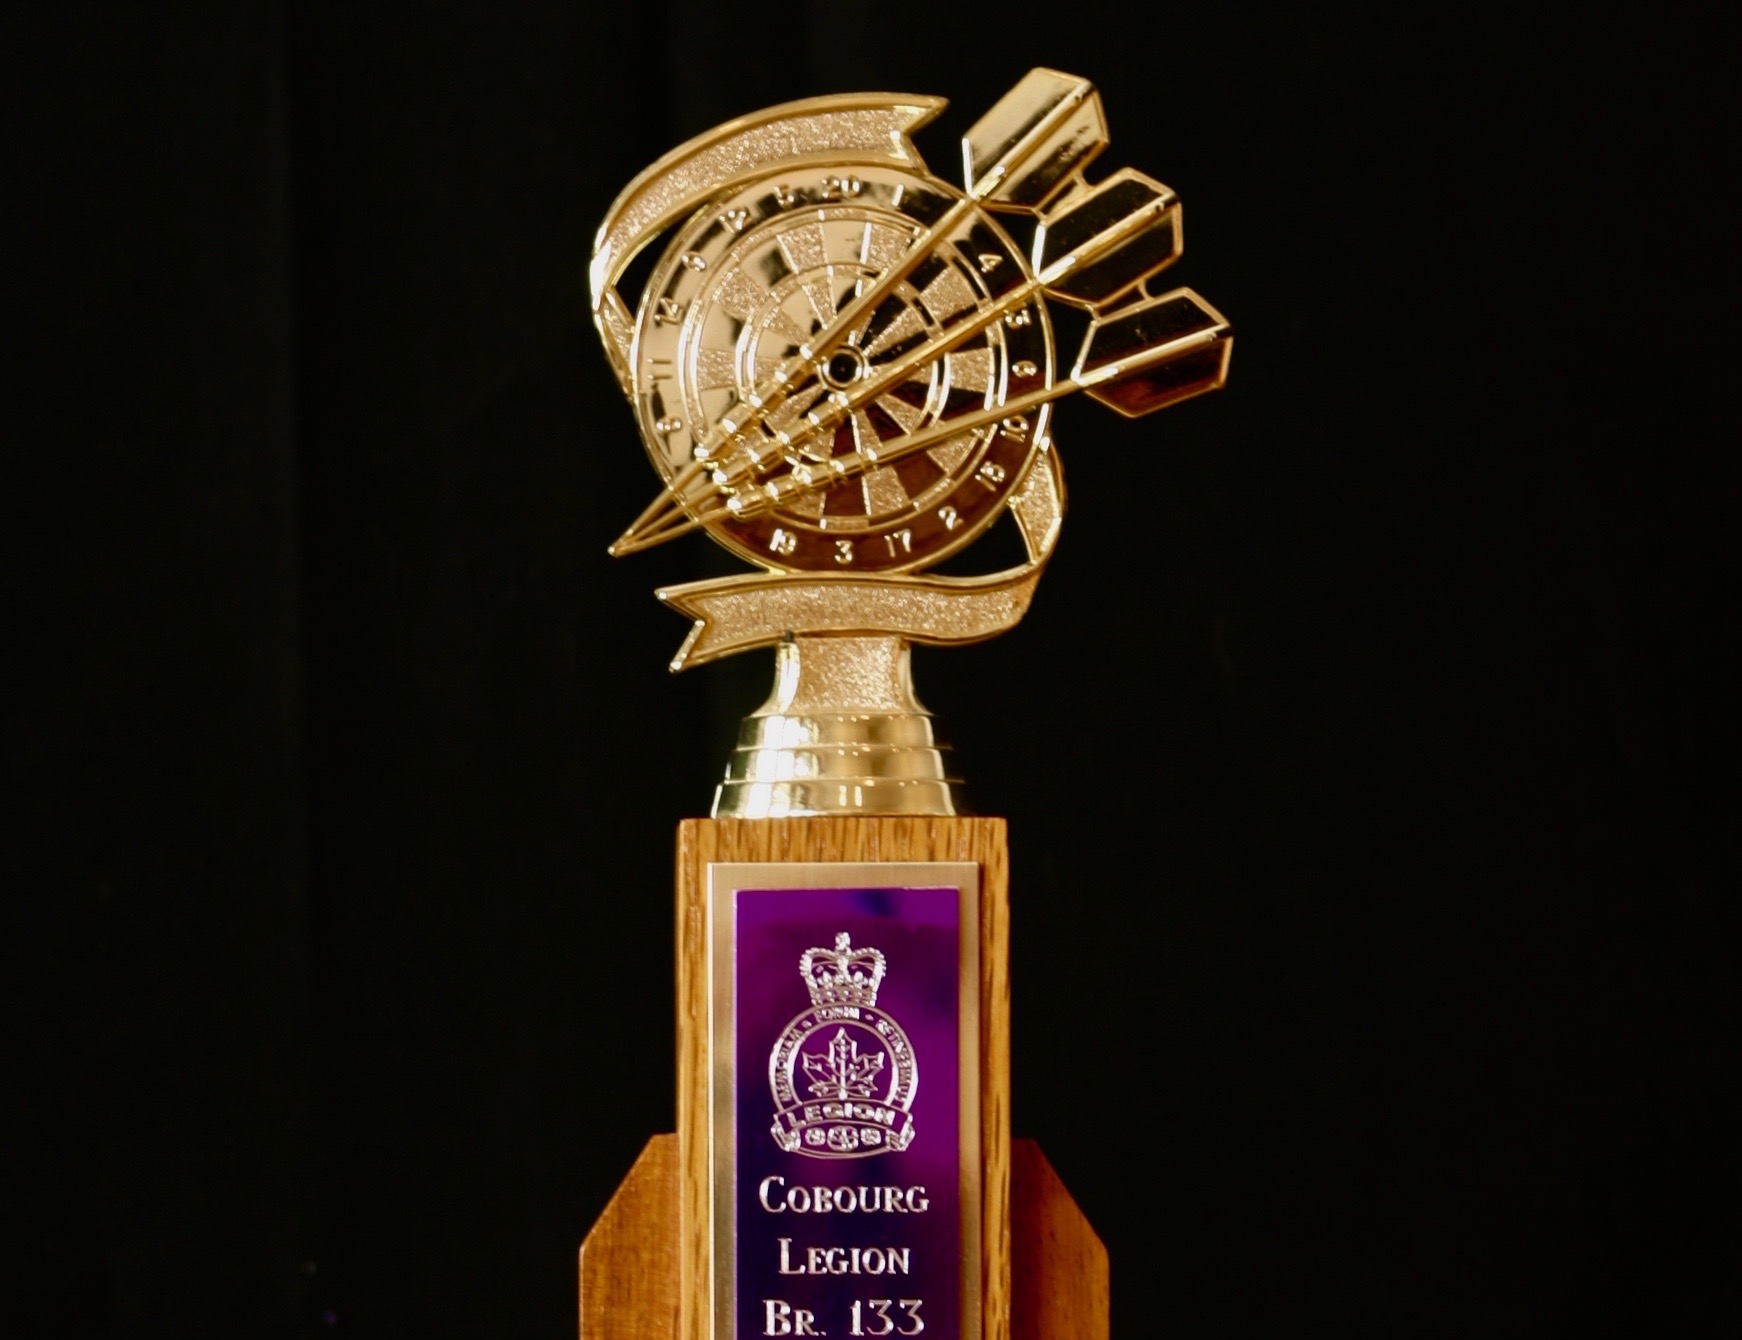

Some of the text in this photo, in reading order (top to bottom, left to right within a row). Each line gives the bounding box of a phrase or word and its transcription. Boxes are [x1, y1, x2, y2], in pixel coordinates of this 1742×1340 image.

[822, 175, 861, 198] 20
[770, 528, 797, 555] 19
[835, 540, 853, 563] 3
[885, 529, 911, 558] 17
[787, 1102, 895, 1127] LEGION
[849, 1299, 925, 1336] 133
